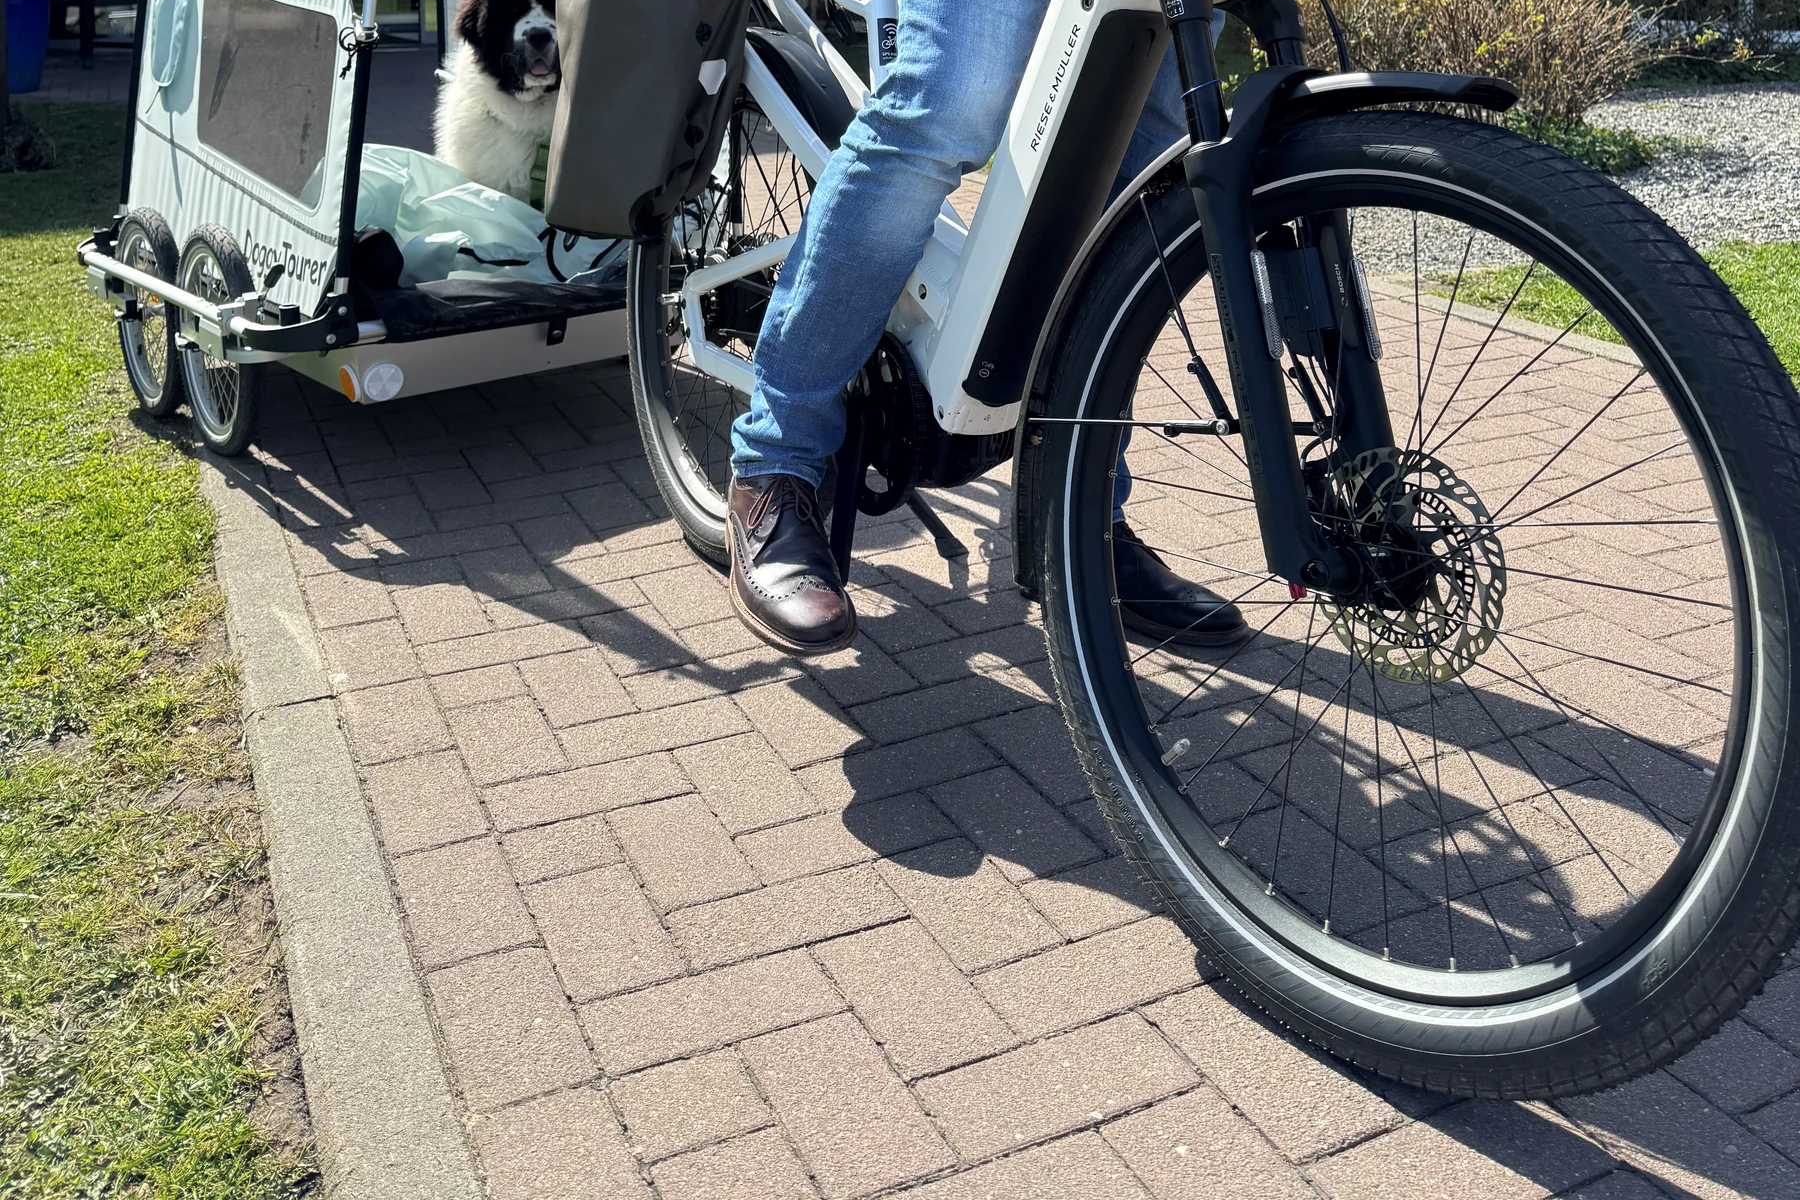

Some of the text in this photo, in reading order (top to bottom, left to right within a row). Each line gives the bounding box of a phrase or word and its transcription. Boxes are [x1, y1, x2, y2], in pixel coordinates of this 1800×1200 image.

[1030, 102, 1054, 152] RIESE
[1052, 23, 1082, 93] MÜLLER
[243, 228, 328, 287] DoggyTourer
[1334, 263, 1345, 294] BOSCH
